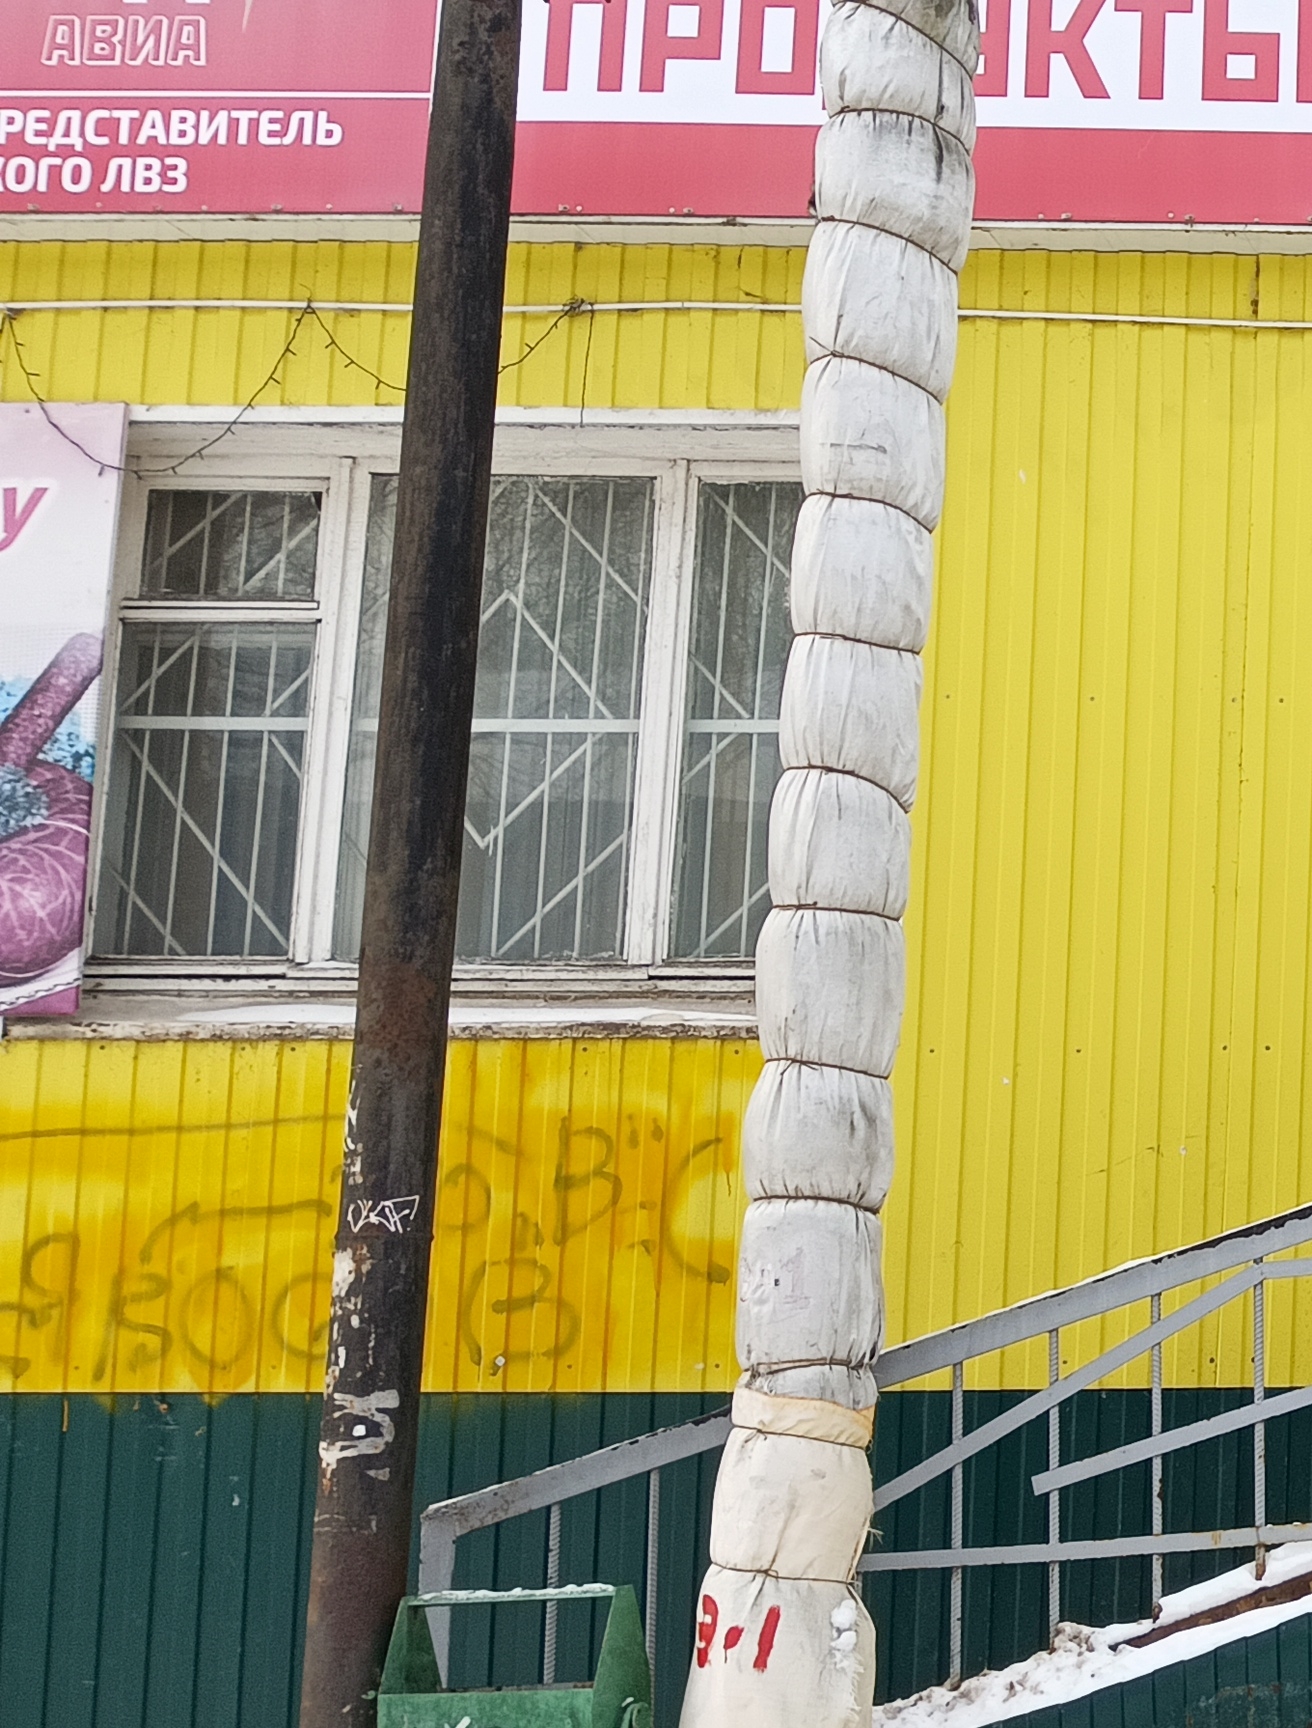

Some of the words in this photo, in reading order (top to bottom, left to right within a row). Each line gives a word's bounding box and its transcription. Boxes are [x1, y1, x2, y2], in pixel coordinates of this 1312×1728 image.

[41, 15, 207, 66] АВИА
[0, 155, 93, 193] ОГО
[100, 156, 189, 193] ЛВЗ
